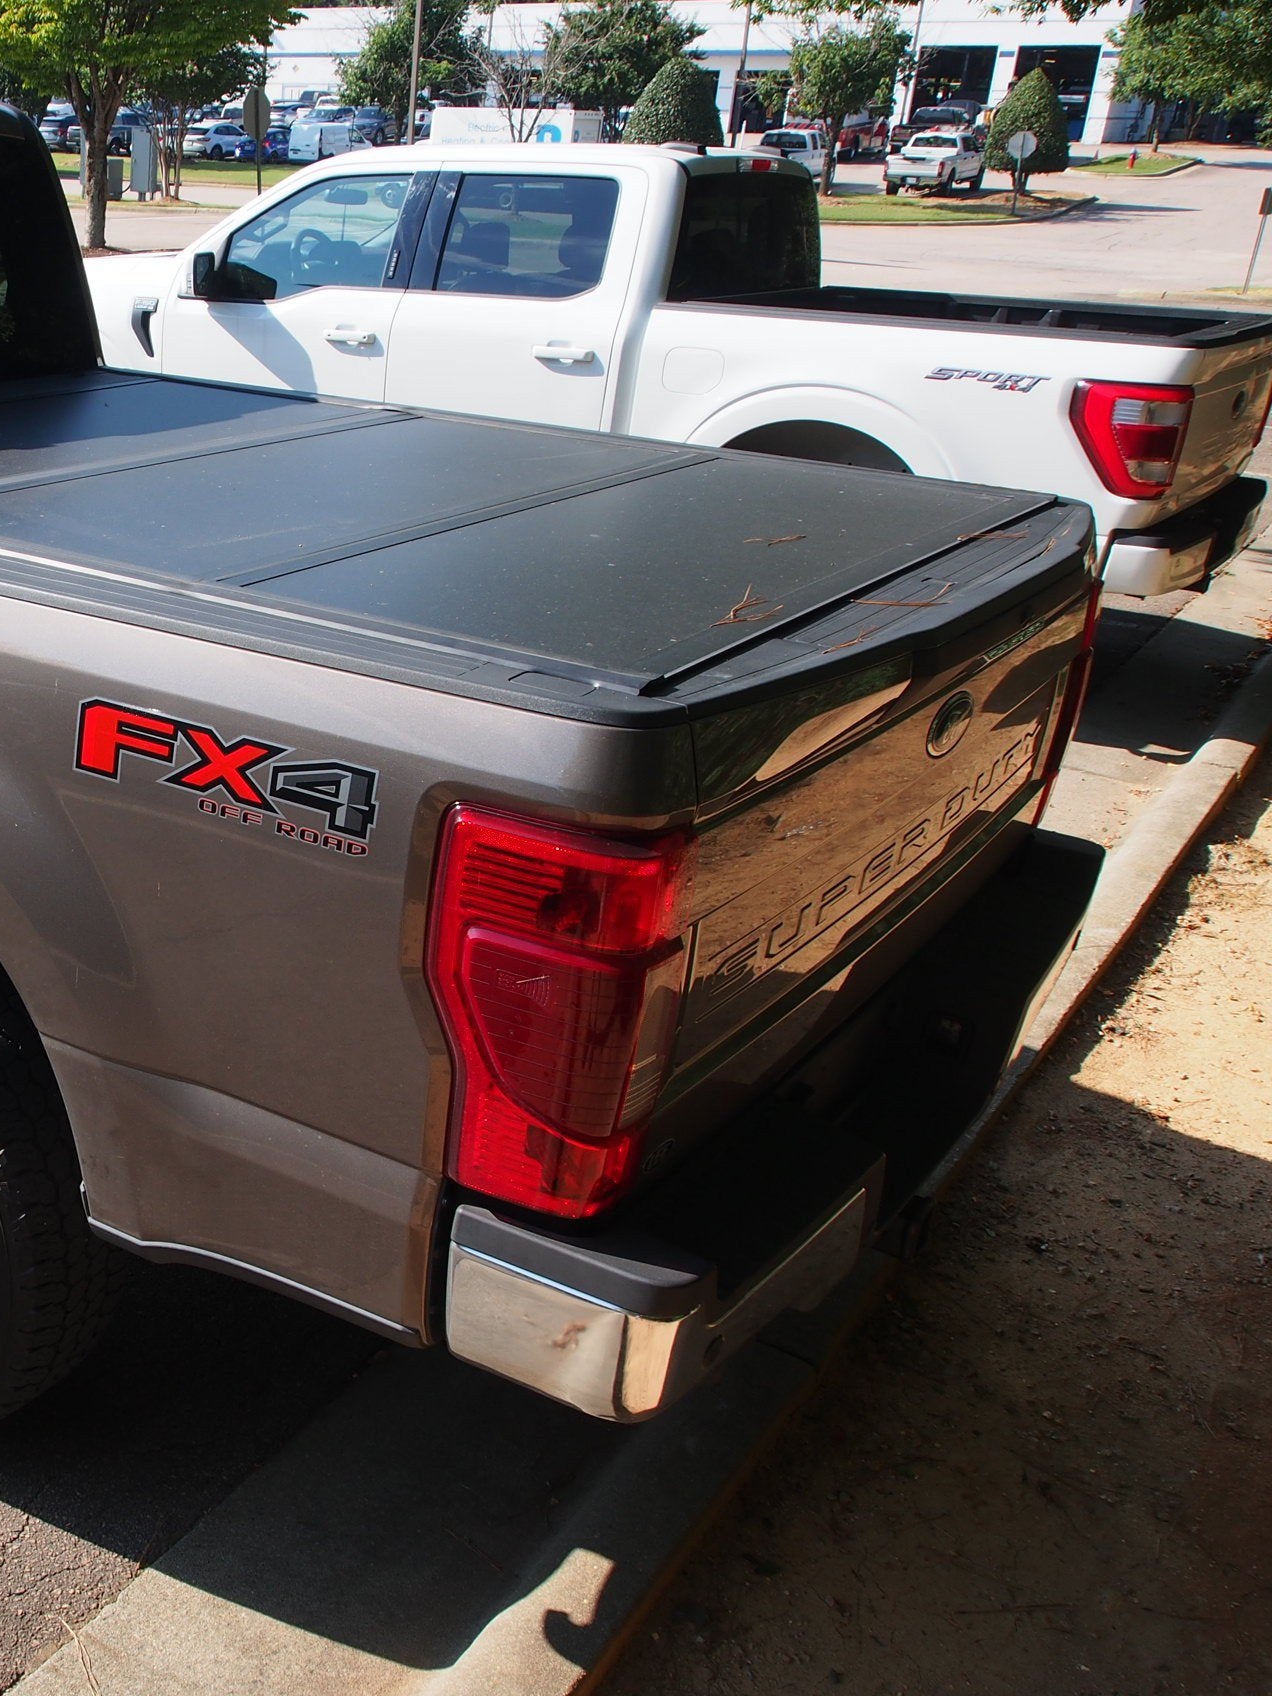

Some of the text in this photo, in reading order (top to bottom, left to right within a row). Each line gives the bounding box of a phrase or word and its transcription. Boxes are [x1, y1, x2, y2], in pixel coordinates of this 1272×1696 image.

[924, 366, 1052, 387] SPORT
[72, 698, 380, 843] FX4
[197, 798, 369, 857] OFF ROAD
[711, 722, 1042, 995] SUPER DUTY
